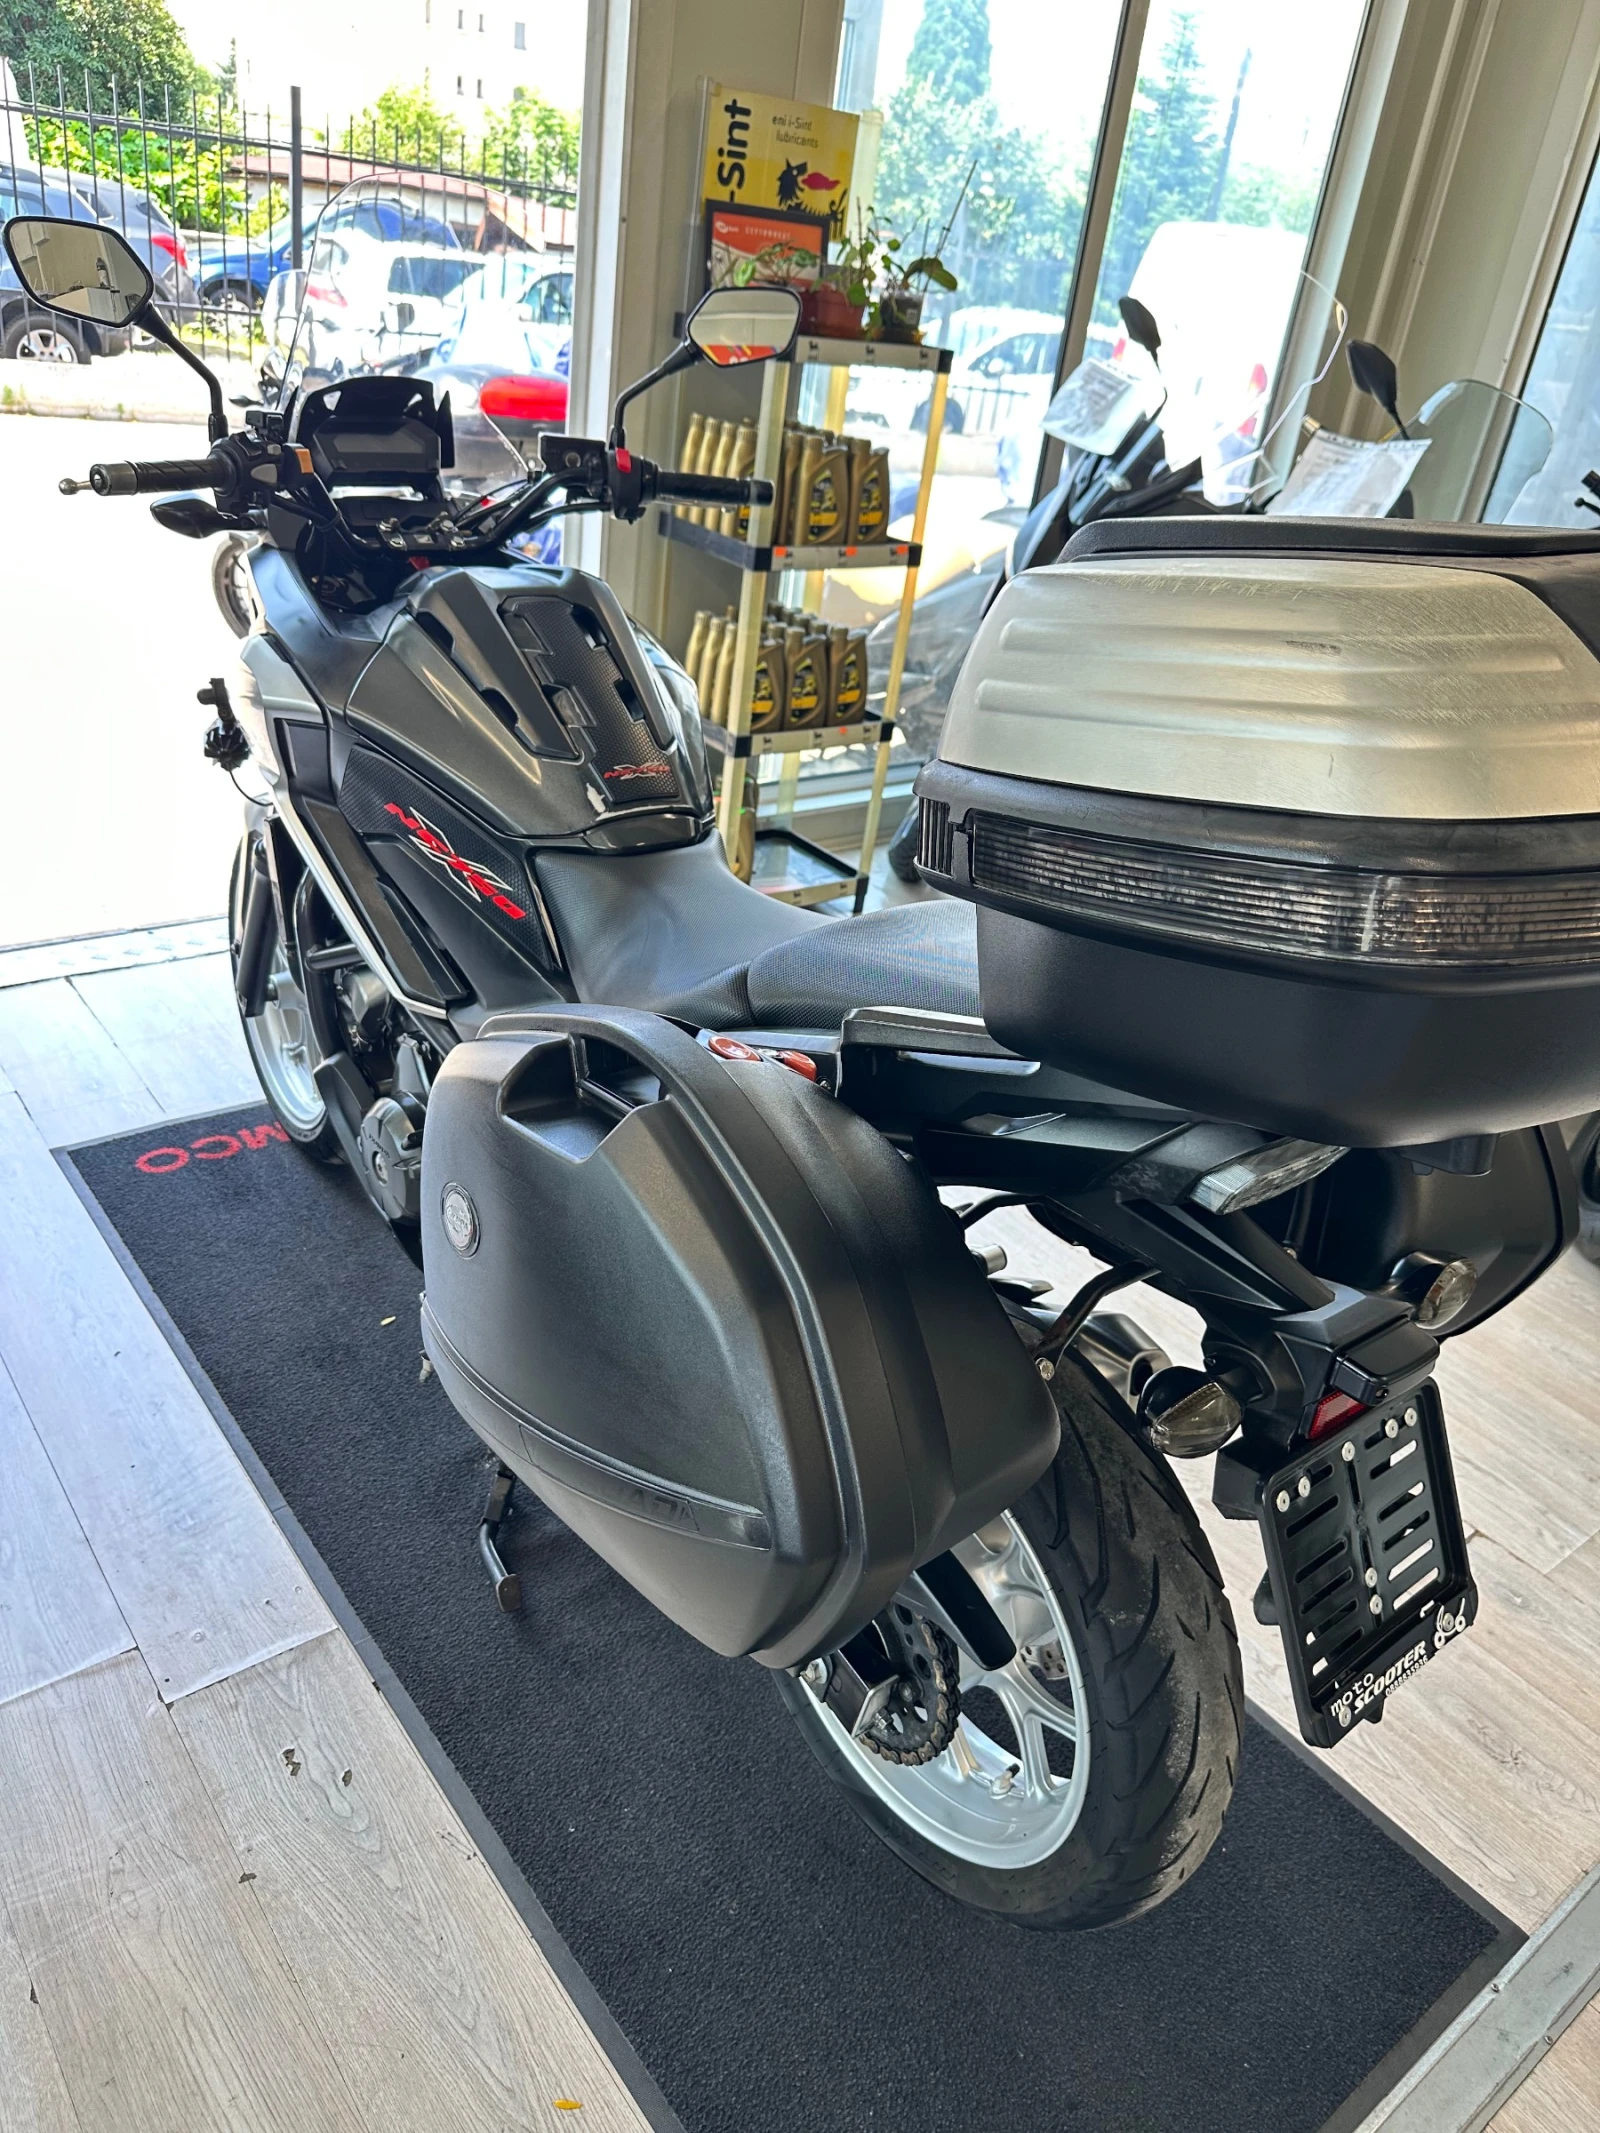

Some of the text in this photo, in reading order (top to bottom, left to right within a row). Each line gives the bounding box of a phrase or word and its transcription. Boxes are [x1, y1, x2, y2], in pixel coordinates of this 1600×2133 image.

[717, 98, 752, 202] -Sint
[776, 129, 819, 149] lubricants
[135, 1121, 292, 1174] MCO
[1330, 1672, 1375, 1717] moto
[1354, 1639, 1427, 1715] SCOOTER
